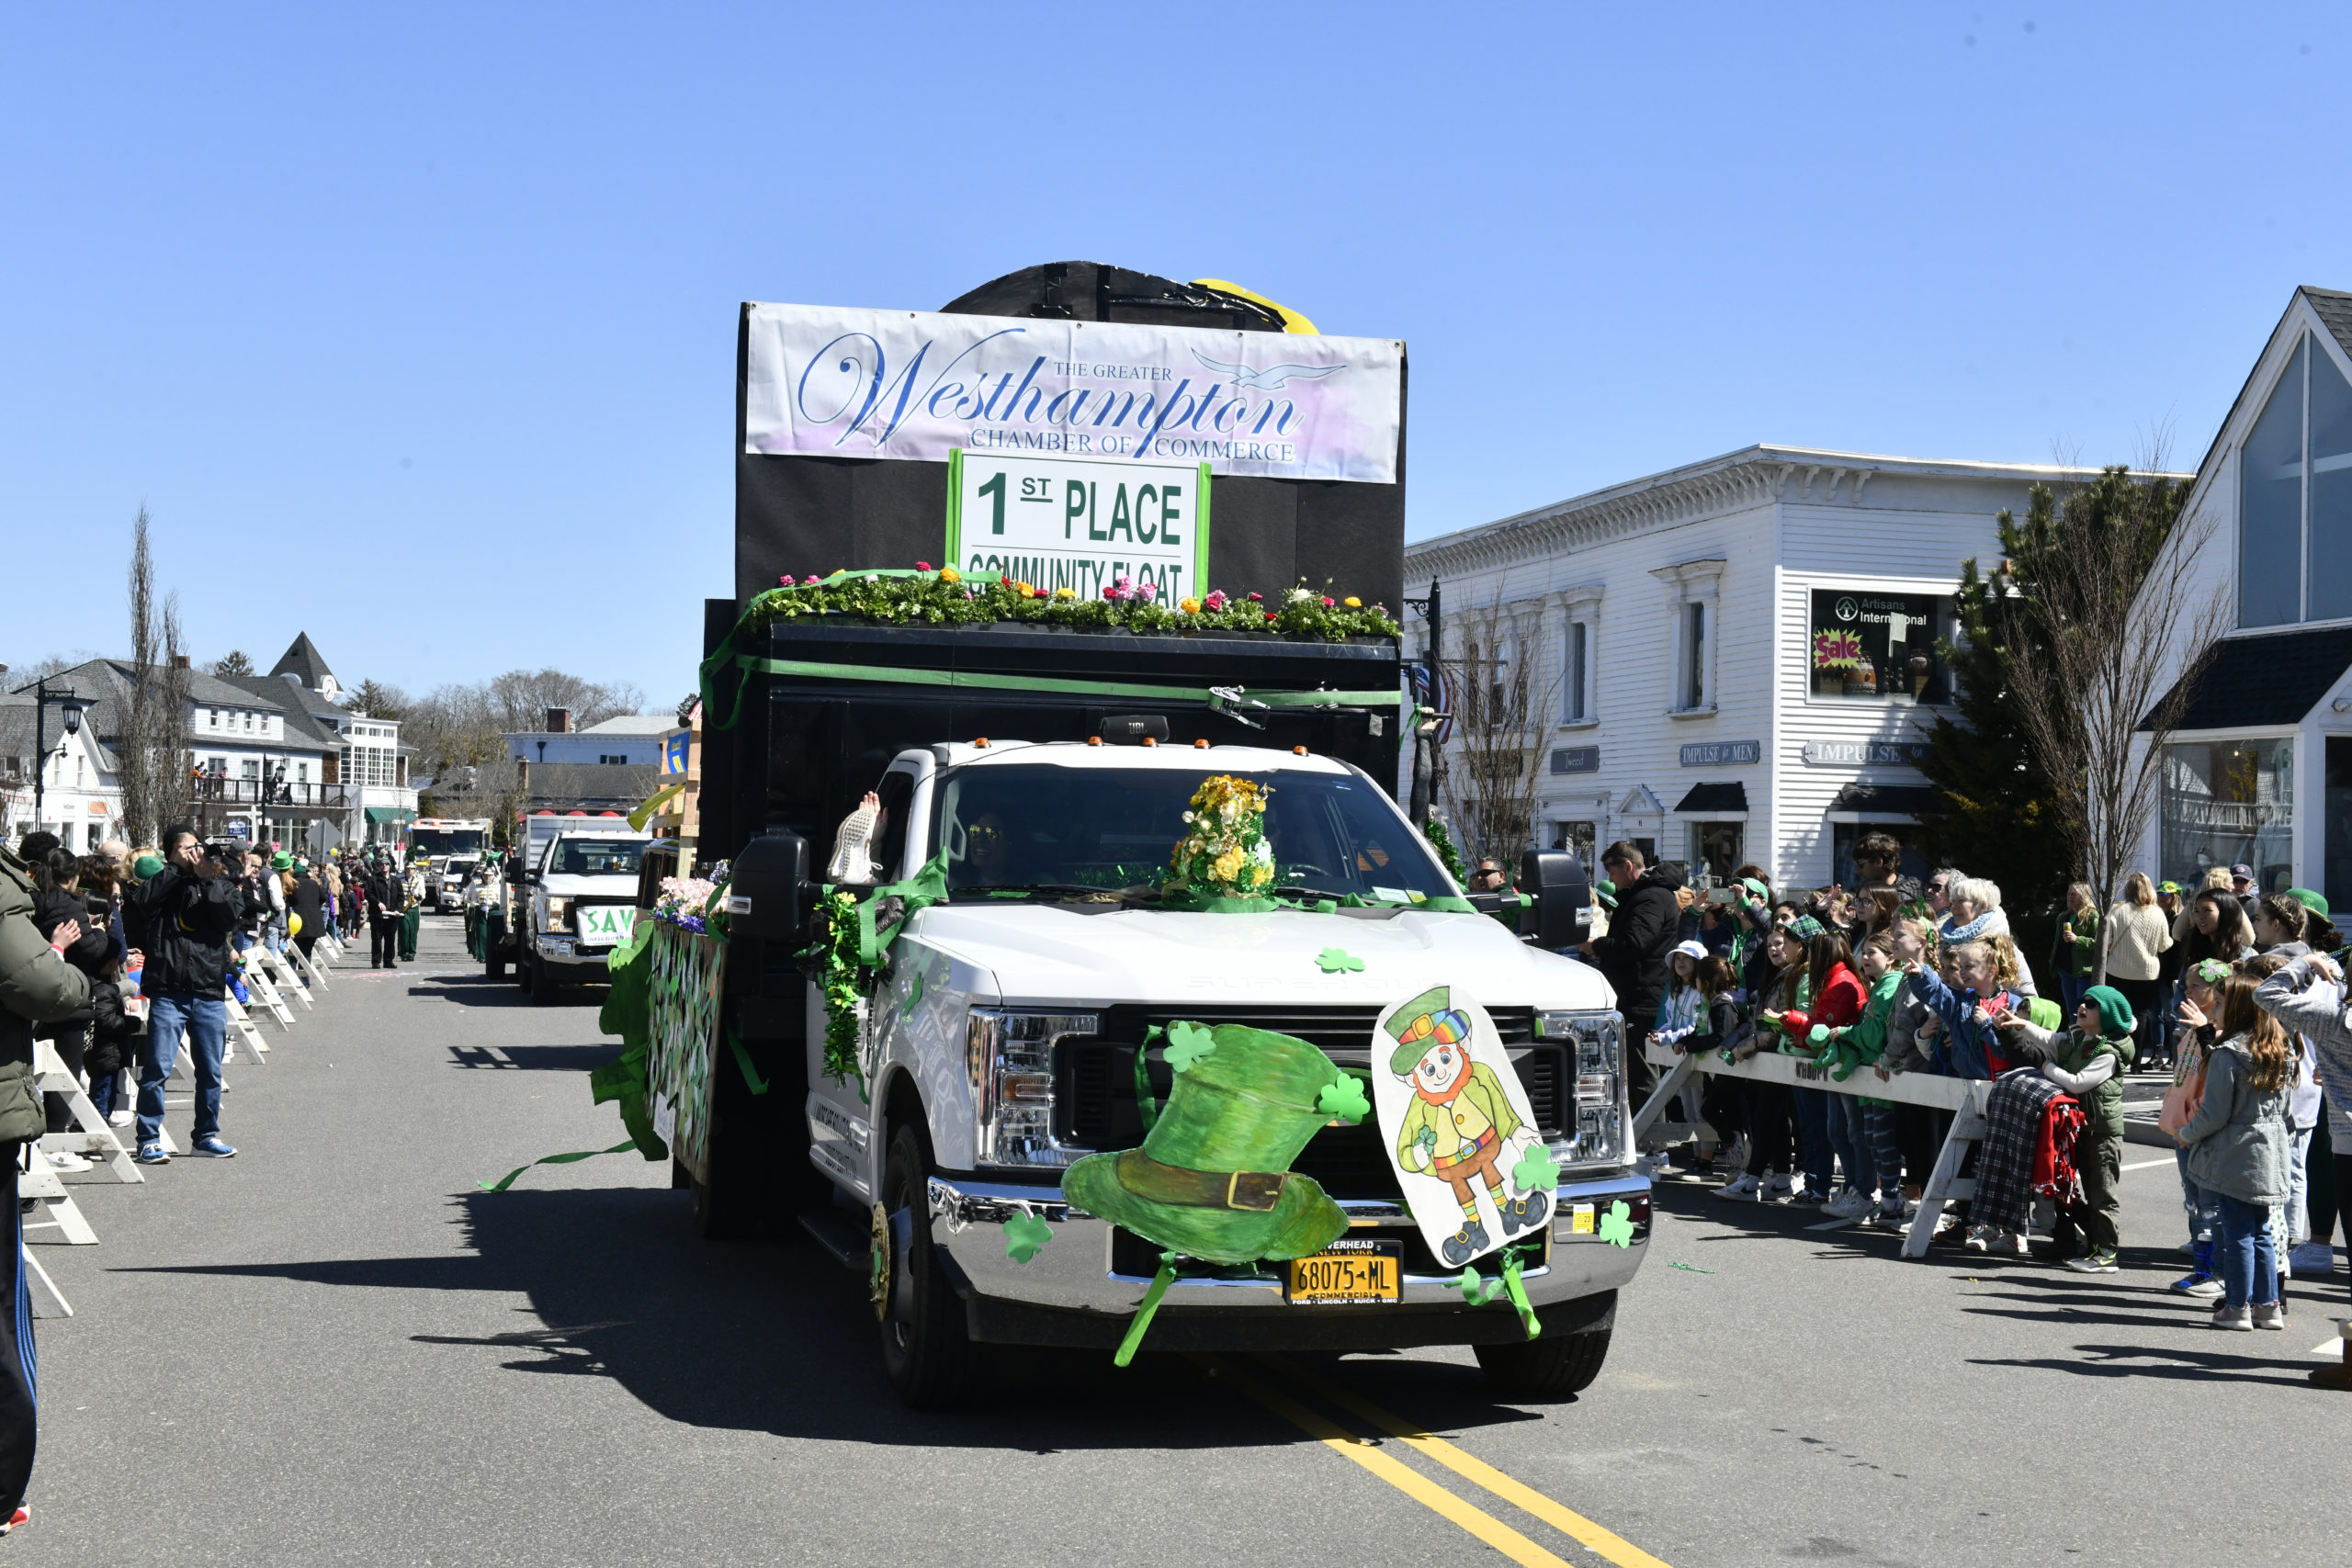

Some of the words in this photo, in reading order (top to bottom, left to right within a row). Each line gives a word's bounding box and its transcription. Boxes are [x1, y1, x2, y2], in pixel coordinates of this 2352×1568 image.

[1055, 361, 1088, 378] THE
[1093, 364, 1172, 382] GREATER
[797, 328, 1306, 458] Westhampton
[970, 428, 1091, 453] CHAMBER
[1101, 434, 1132, 455] OF
[1155, 437, 1294, 462] COMMERCE
[1065, 479, 1182, 546] PLACE
[1860, 598, 1905, 611] Artisans
[1860, 611, 1927, 626] Internonal
[1815, 632, 1860, 664] Sale
[1128, 722, 1148, 735] JBL
[1563, 752, 1585, 770] Tweed
[1683, 746, 1720, 763] IMPULSE
[1732, 744, 1753, 761] MEN
[1816, 743, 1902, 762] IMPULSE
[1326, 1240, 1374, 1250] VERHEAD
[1314, 1291, 1376, 1300] COMMERCIAL
